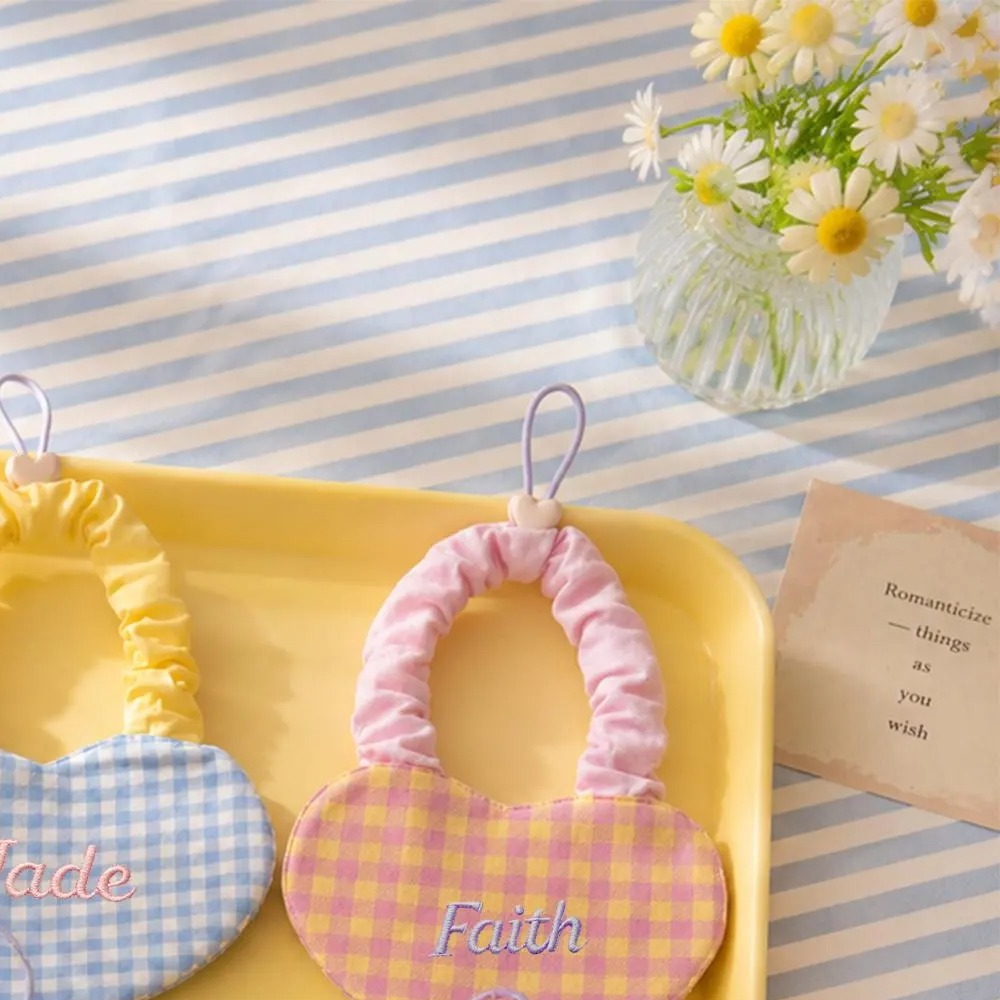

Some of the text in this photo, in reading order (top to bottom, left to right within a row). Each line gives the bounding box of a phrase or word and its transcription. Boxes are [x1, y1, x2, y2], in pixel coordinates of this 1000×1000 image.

[884, 582, 993, 625] Romanticize
[915, 624, 972, 653] things
[912, 659, 932, 673] as
[898, 688, 932, 708] you
[888, 718, 929, 741] wish
[428, 900, 590, 957] Faith
